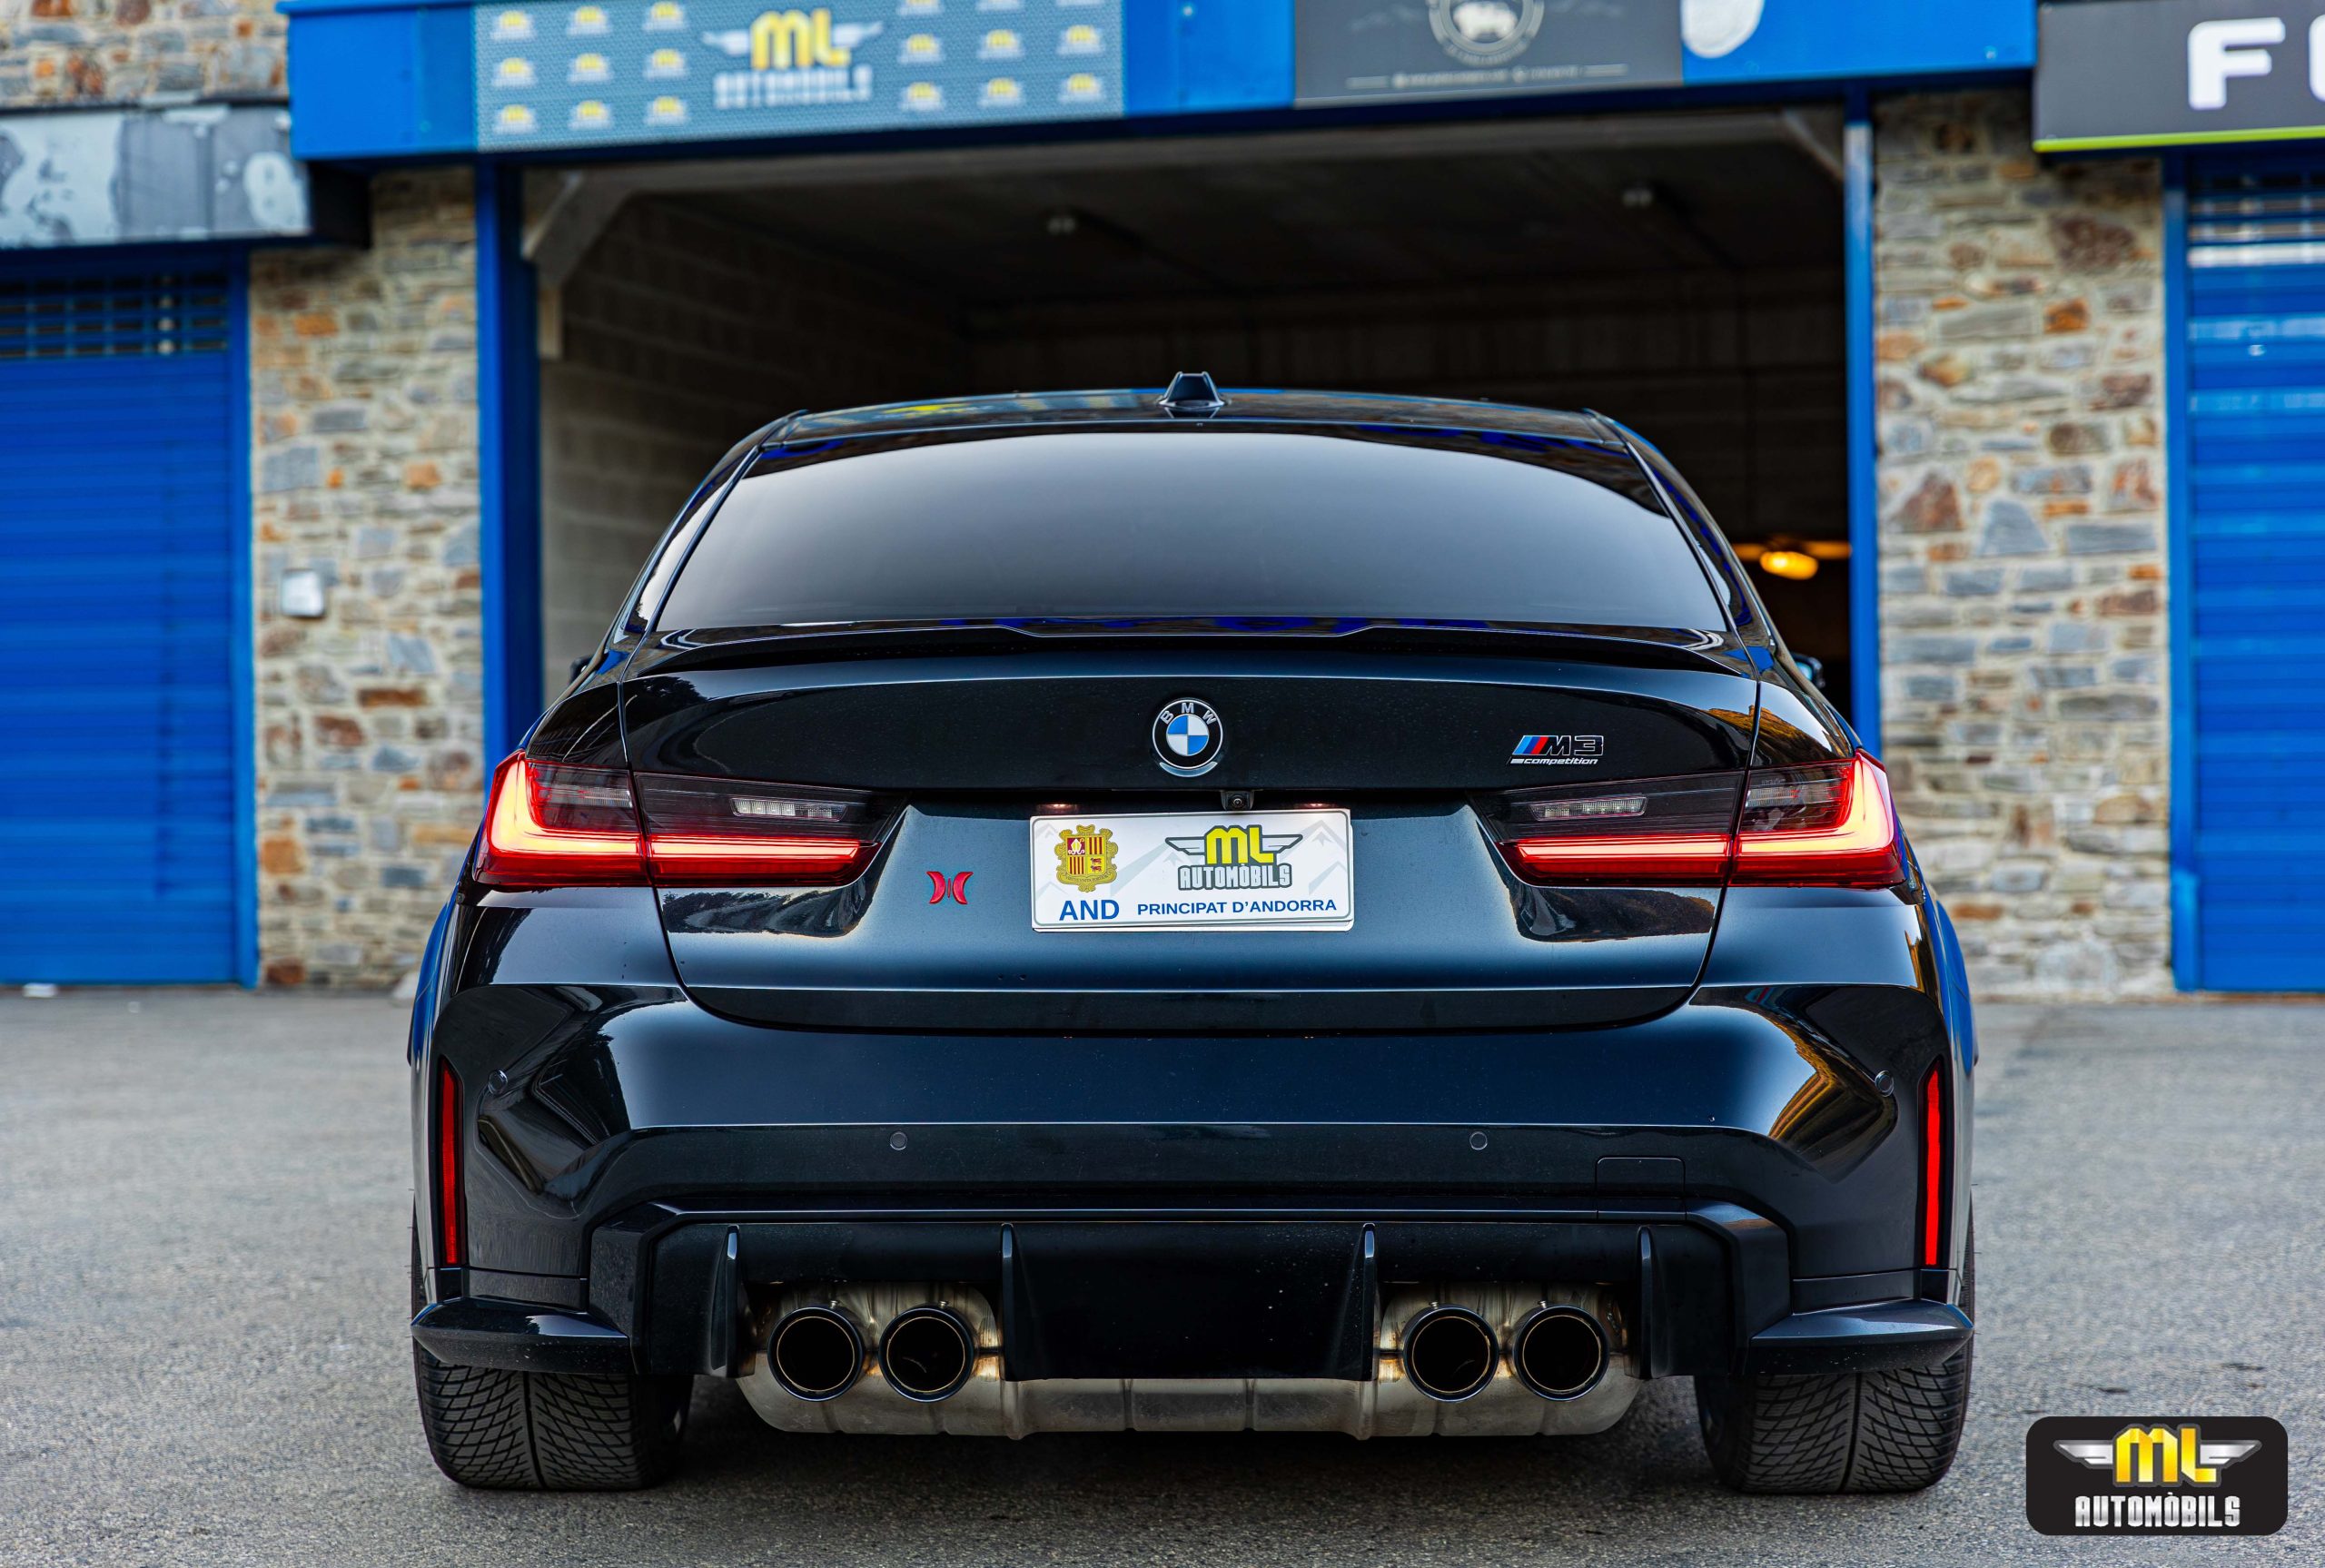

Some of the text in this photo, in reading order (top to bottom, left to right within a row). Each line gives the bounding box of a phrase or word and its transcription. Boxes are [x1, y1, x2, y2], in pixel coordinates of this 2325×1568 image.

[750, 7, 851, 70] ML
[2187, 15, 2325, 111] F
[1160, 702, 1217, 725] BMW
[1523, 757, 1598, 765] competition
[1206, 826, 1274, 864] ML
[1059, 900, 1120, 921] AND
[1137, 902, 1227, 915] PRINCIPAT
